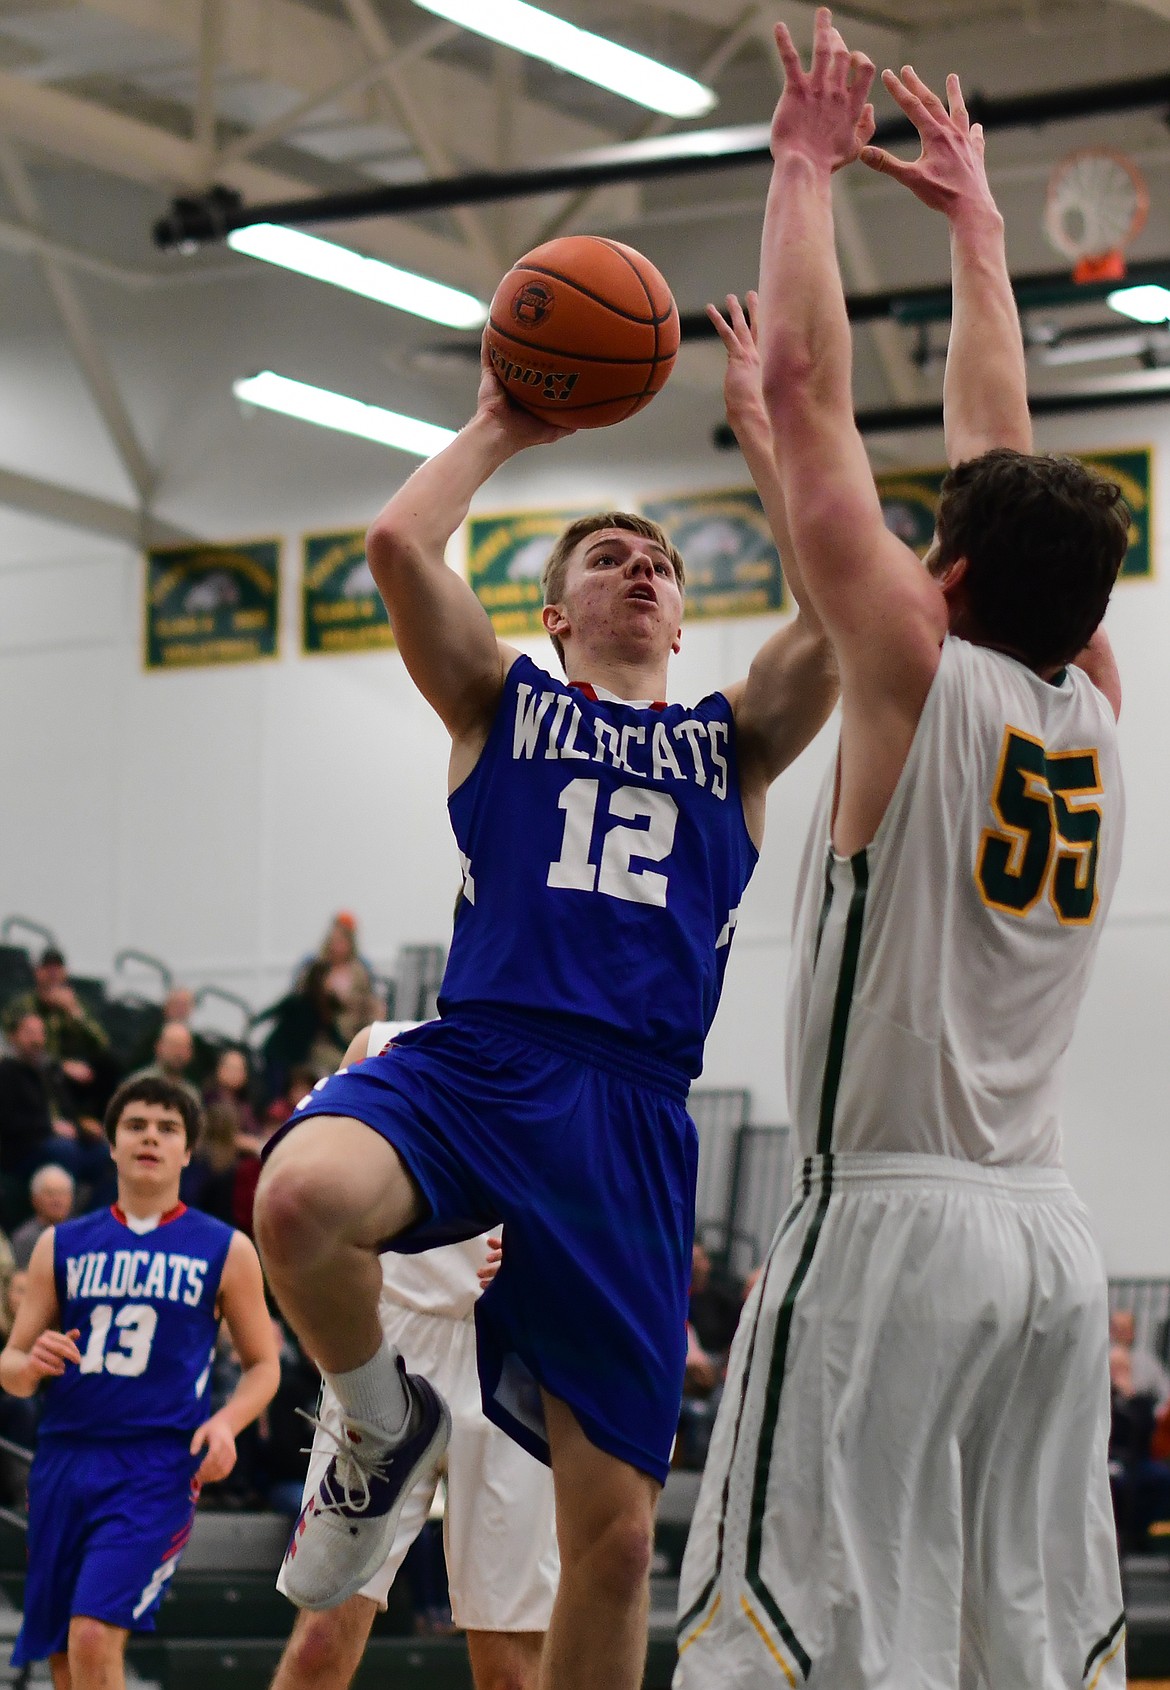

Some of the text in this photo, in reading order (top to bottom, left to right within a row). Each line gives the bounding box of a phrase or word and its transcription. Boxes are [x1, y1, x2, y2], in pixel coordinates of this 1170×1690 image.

[512, 682, 729, 801] WILDCATS
[546, 777, 680, 908] 12
[973, 724, 1104, 927] 55
[66, 1250, 208, 1307] WILDCATS
[79, 1304, 158, 1377] 13
